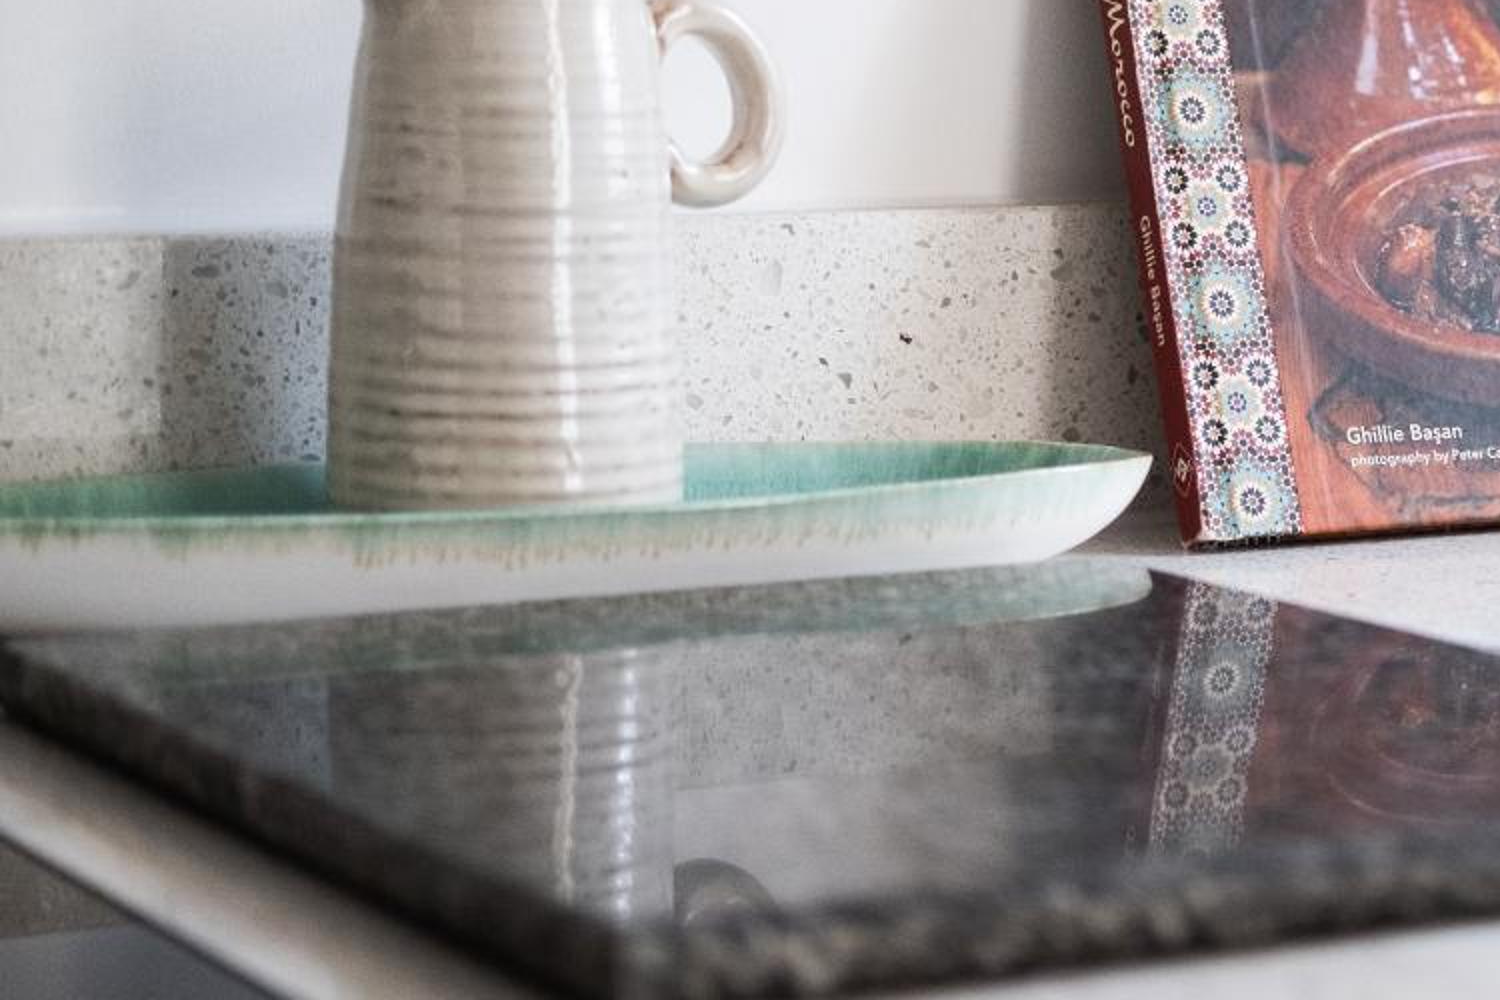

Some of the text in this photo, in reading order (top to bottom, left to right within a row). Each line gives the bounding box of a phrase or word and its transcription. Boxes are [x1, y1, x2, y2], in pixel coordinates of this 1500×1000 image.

[1139, 215, 1156, 281] Ghillie
[1346, 423, 1463, 444] Ghillie Başan
[1351, 450, 1430, 467] photography
[1433, 451, 1449, 464] by
[1452, 448, 1483, 461] Peter
